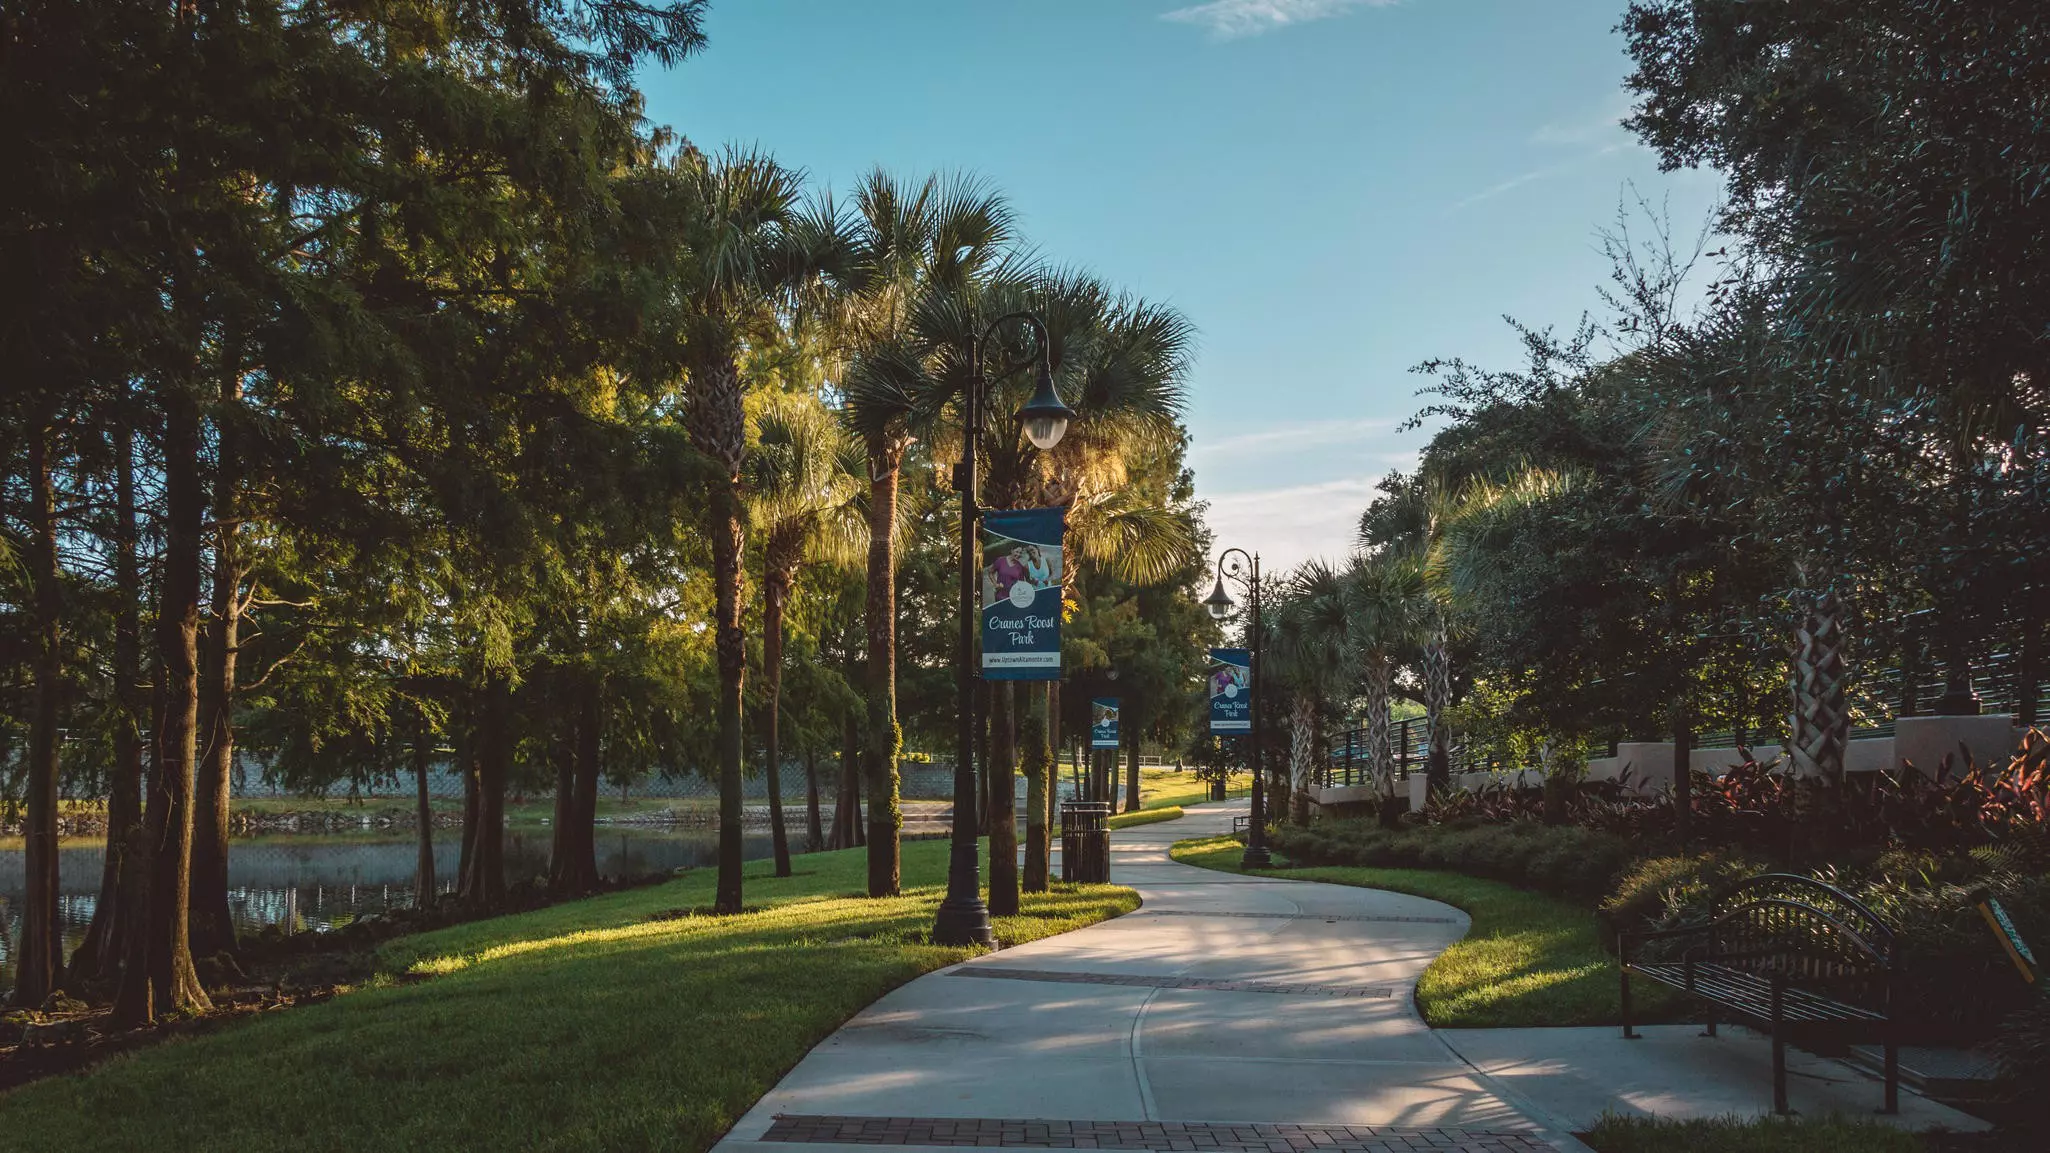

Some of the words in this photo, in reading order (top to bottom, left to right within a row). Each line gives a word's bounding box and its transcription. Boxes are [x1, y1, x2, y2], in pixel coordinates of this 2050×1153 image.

[989, 616, 1024, 630] Cranes
[1025, 615, 1054, 629] Roost
[1008, 631, 1034, 646] Park
